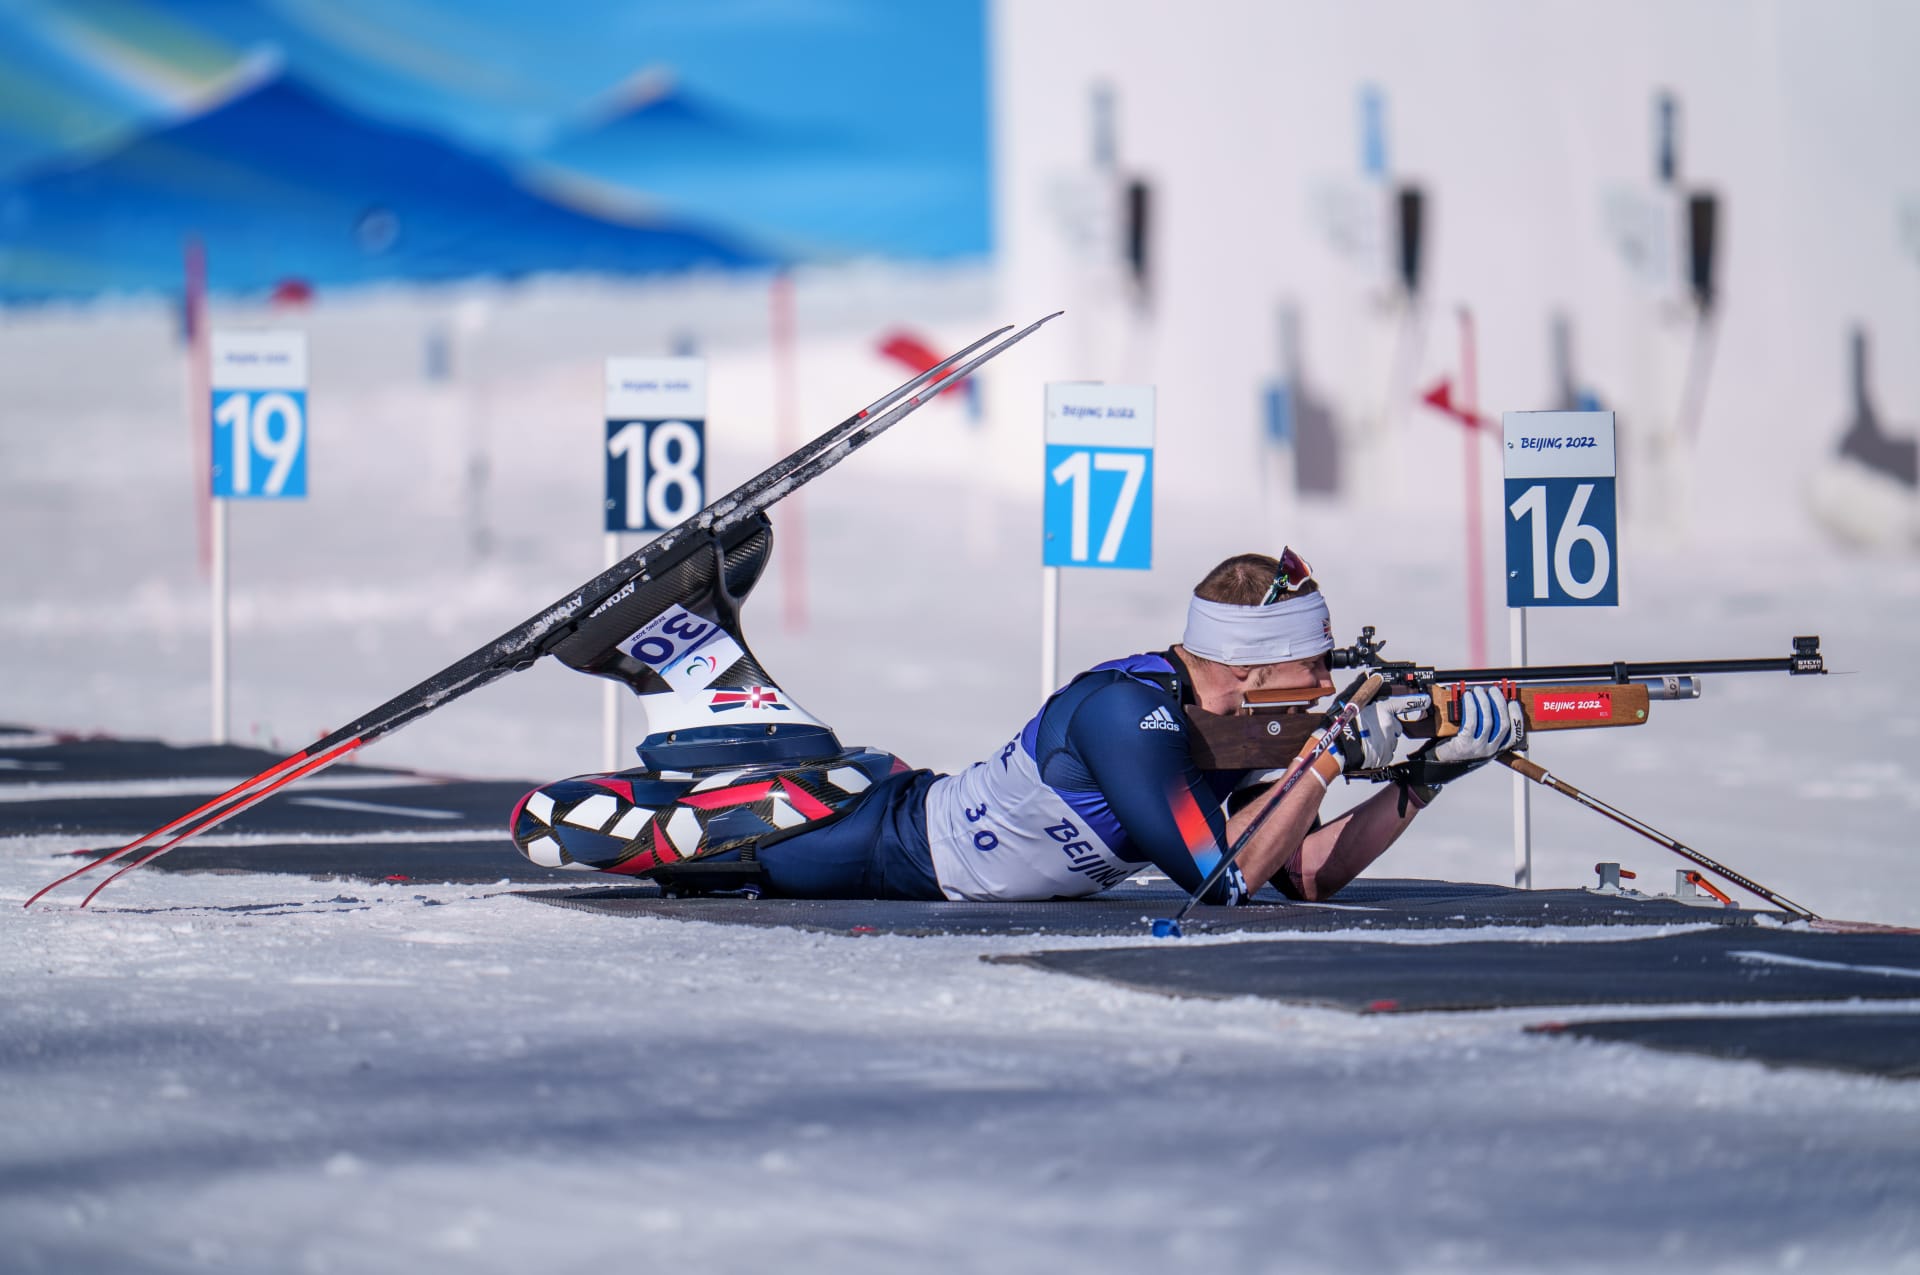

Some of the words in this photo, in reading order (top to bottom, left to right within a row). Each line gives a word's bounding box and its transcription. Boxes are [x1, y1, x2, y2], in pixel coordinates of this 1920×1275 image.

[214, 392, 302, 494] 19
[608, 420, 701, 530] 18
[1520, 437, 1562, 452] BEIJING
[1565, 436, 1598, 448] 2022
[1051, 451, 1147, 562] 17
[1508, 483, 1611, 600] 16
[630, 612, 708, 665] 30
[1140, 720, 1180, 731] adidas
[1543, 701, 1576, 713] BEIJING
[1577, 700, 1603, 710] 2022
[1043, 817, 1128, 890] BEIJING
